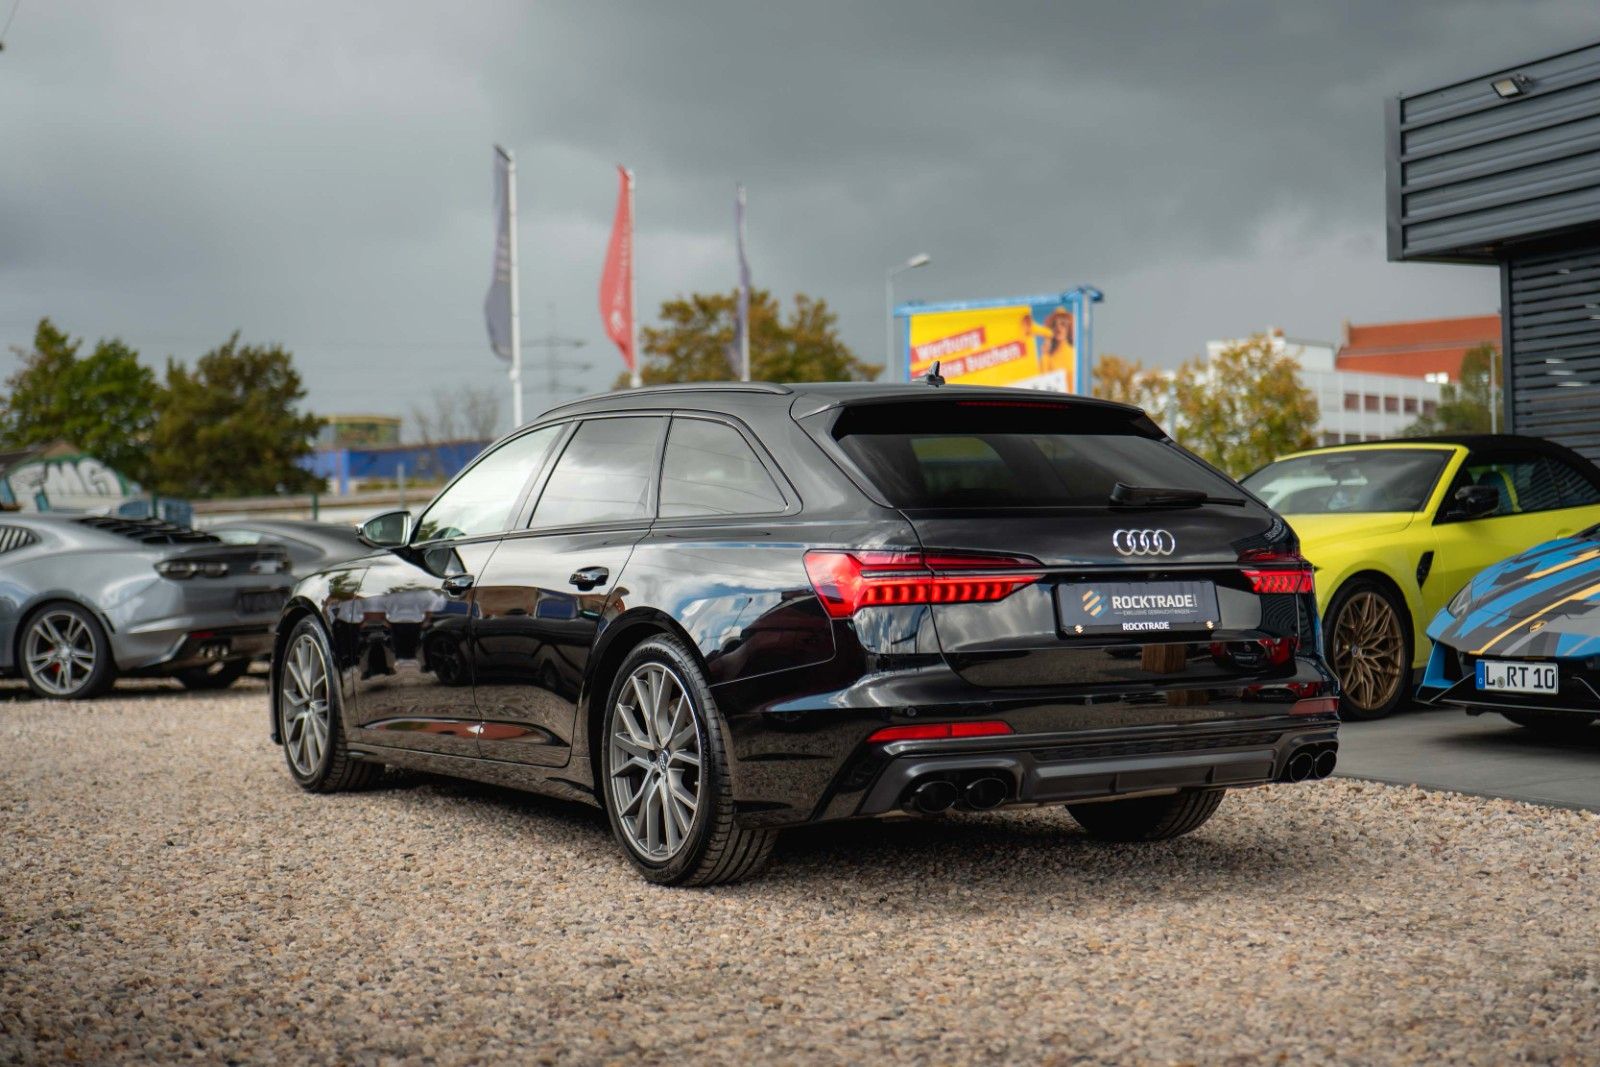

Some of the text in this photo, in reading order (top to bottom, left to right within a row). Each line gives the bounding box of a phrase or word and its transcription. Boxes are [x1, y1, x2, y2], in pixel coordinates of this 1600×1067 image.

[1111, 594, 1193, 609] ROCKTRADE
[1122, 621, 1170, 631] ROCKTRADE
[1485, 665, 1555, 689] L RT 10
